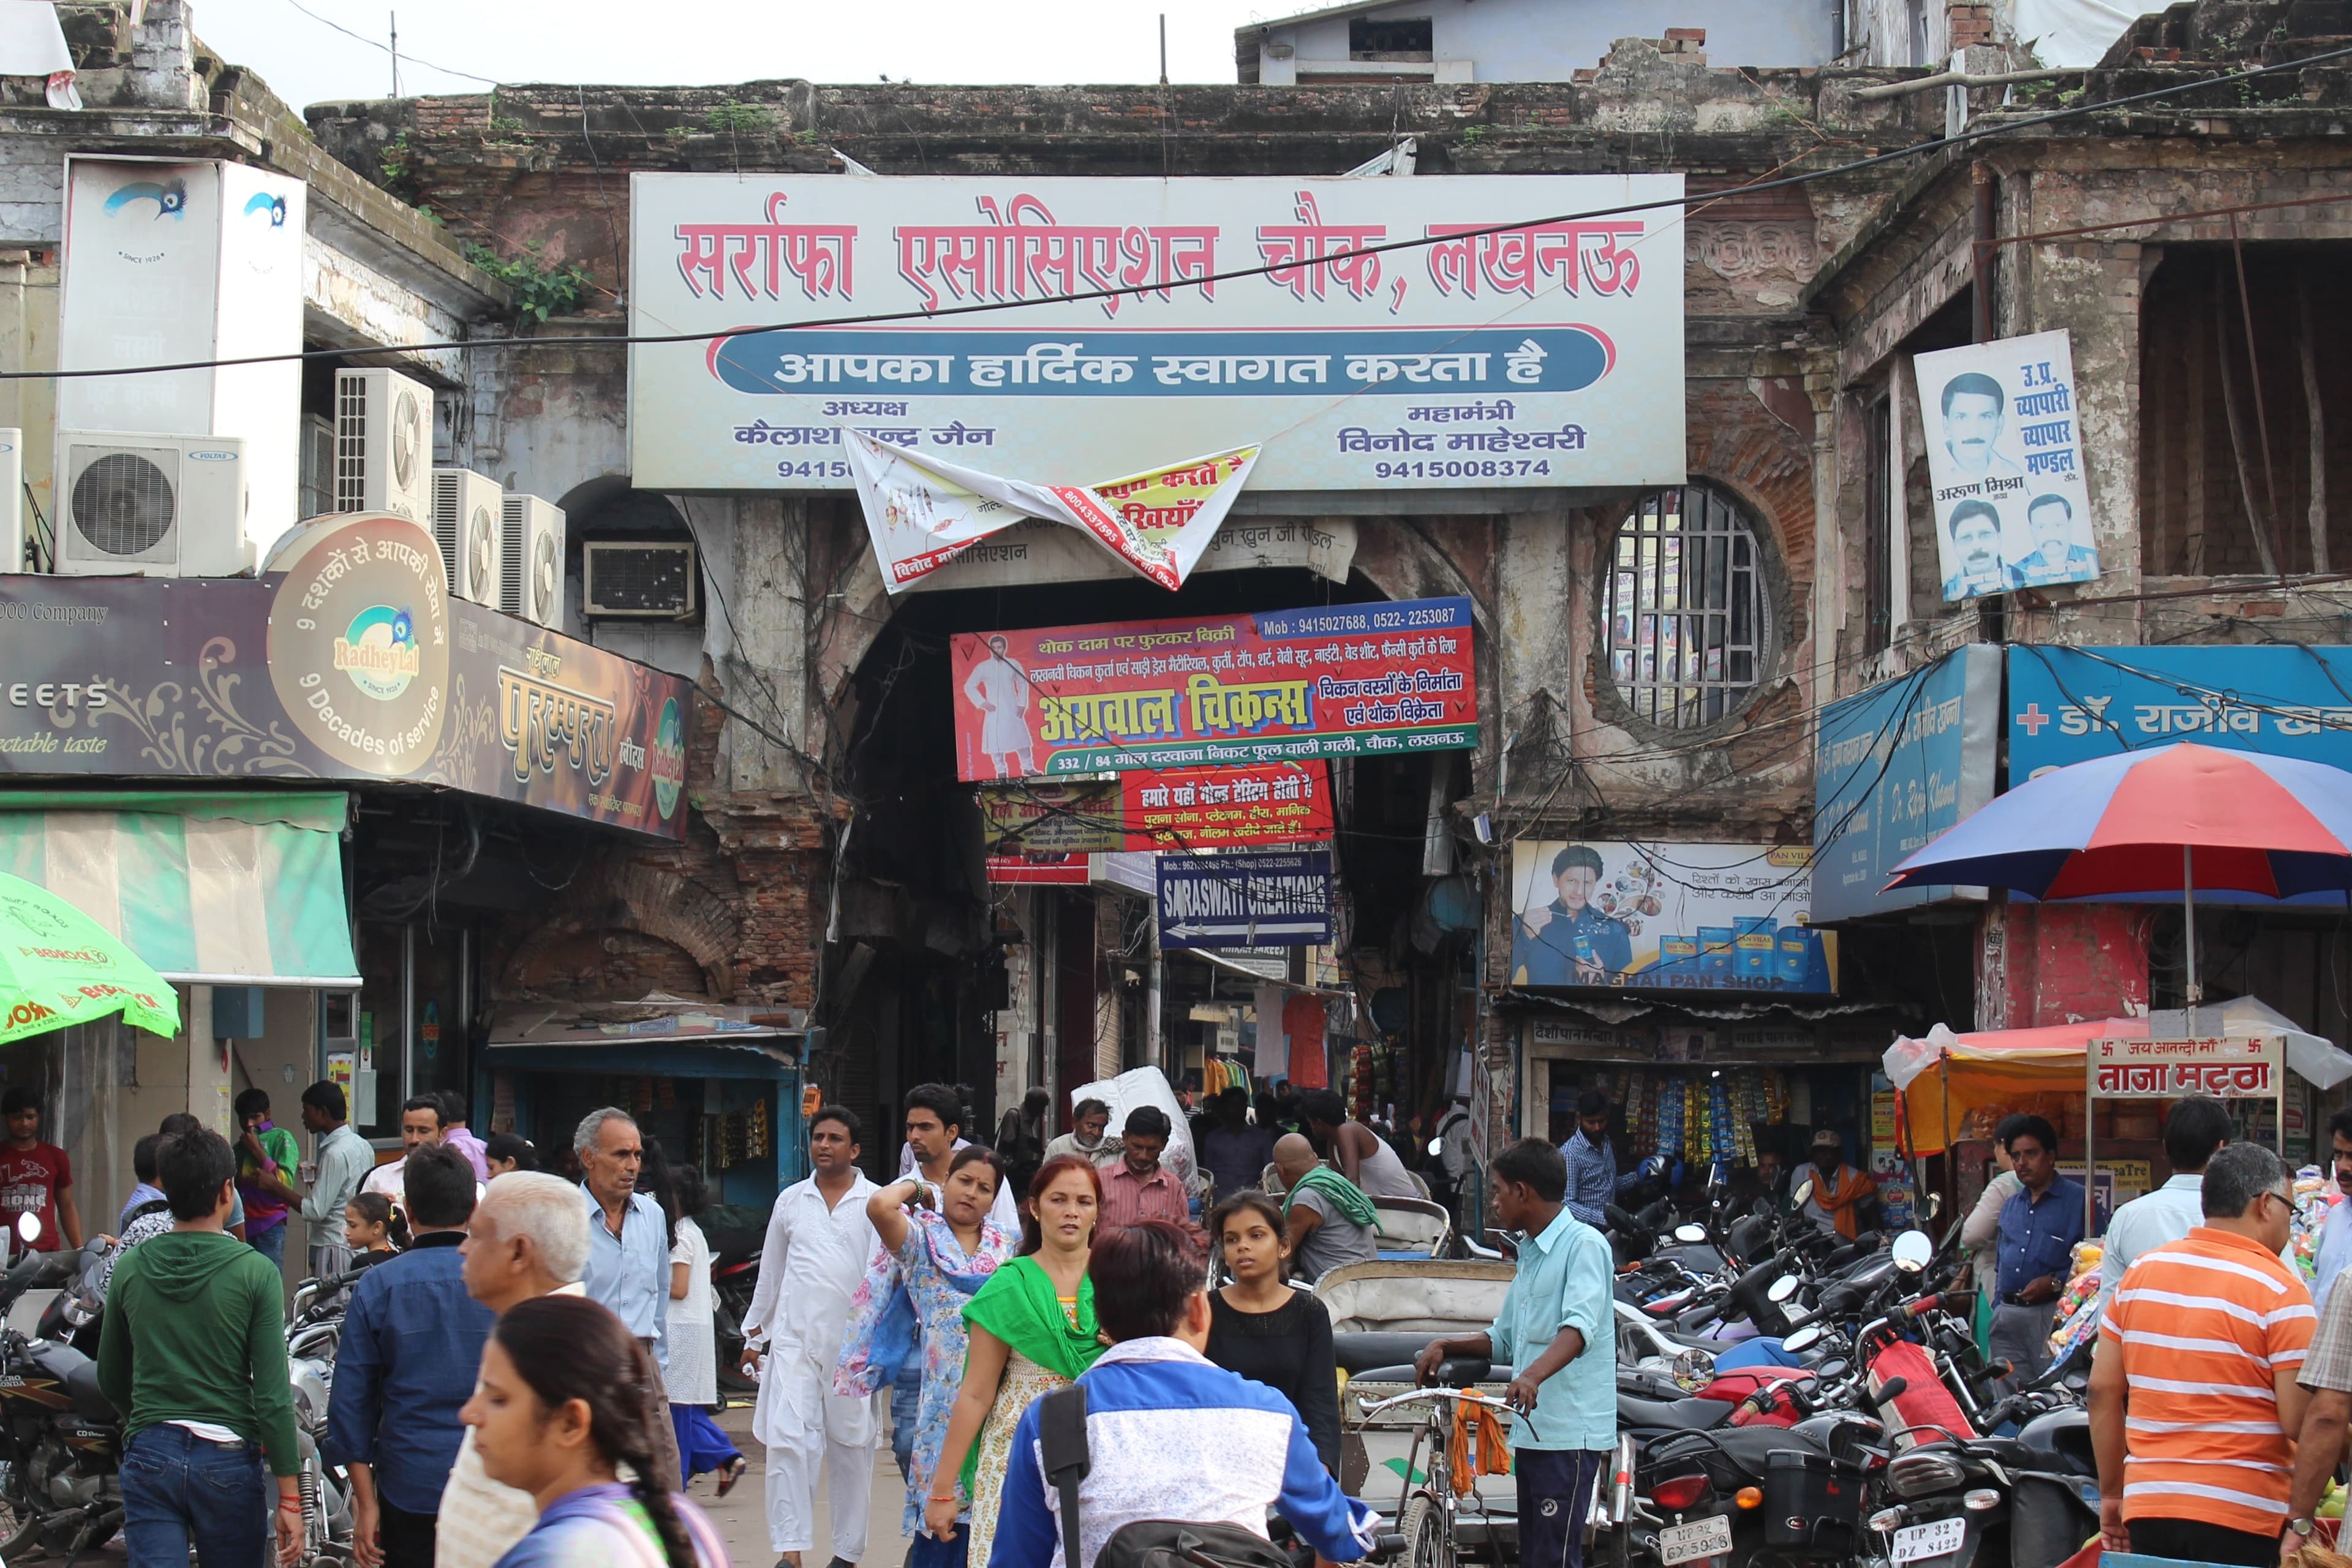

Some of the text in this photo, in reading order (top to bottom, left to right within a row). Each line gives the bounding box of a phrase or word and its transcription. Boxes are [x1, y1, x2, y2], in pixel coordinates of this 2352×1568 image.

[123, 252, 160, 264] SINCE 1926
[675, 191, 1645, 318] सर्राफा एसोसिएशन चौक, लखनऊ
[774, 338, 1547, 386] आपका हार्दिक स्वागत करता है
[2020, 361, 2057, 387] उ.प्र.
[822, 401, 909, 417] अध्यक्ष
[1408, 399, 1516, 423] महामंत्री
[2014, 383, 2070, 417] व्यापारी
[734, 418, 842, 445] कैलाश
[930, 421, 996, 447] जैन
[1338, 424, 1587, 452] विनोद माहेश्वरी
[2020, 420, 2071, 447] व्यापार
[1376, 460, 1550, 478] 9415008374
[2025, 448, 2075, 476] मण्डल
[1985, 476, 2024, 494] मिश्रा
[1064, 490, 1118, 543] 8004337595
[301, 549, 352, 609] दशकों
[350, 536, 371, 565] से
[375, 540, 429, 581] आपकी
[425, 575, 440, 620] सेवा
[32, 602, 108, 626] Company
[1264, 620, 1288, 636] Mob
[1298, 614, 1370, 633] 9415027688,
[1373, 612, 1405, 628] 0522-
[1408, 608, 1455, 625] 2253087
[1038, 625, 1235, 655] थोक दाम पर फुटकर बिक्री
[335, 639, 419, 674] RadheyLal
[526, 641, 562, 679] राधेलाल
[1030, 662, 1065, 684] लखनवी
[1066, 663, 1093, 680] चिकन
[1095, 660, 1114, 683] कुर्ता
[1117, 658, 1129, 676] एवं
[1439, 636, 1457, 655] लिए
[0, 683, 108, 708] EETS
[368, 682, 398, 694] SINCE 1926
[1318, 675, 1359, 699] चिकन
[1397, 673, 1414, 693] के
[1415, 667, 1463, 693] निर्माता
[299, 673, 439, 756] 9 Decades of service
[1039, 673, 1312, 742] अग्रवाल चिकन्स
[1344, 698, 1444, 726] एवं थोक विक्रेता
[2058, 693, 2262, 734] डॉ. राजीव
[498, 665, 615, 786] परम्परा
[64, 736, 108, 753] taste
[1058, 755, 1080, 770] 332
[1095, 753, 1111, 767] 84
[1152, 748, 1203, 763] दरवाजा
[1207, 744, 1250, 760] निकट
[1252, 743, 1283, 761] फूल
[1286, 737, 1319, 756] वाली
[1323, 736, 1360, 754] गली,
[1365, 734, 1403, 751] चौक,
[1408, 731, 1464, 747] लखनऊ
[1140, 784, 1169, 809] हमारे
[1173, 782, 1195, 807] यहाँ
[1273, 775, 1300, 800] होती
[1144, 813, 1172, 829] पुराना
[1175, 809, 1201, 823] सोना,
[1200, 825, 1229, 839] नीलम
[1692, 872, 1719, 884] रिश्तों
[1725, 873, 1740, 886] को
[1745, 876, 1771, 886] खास
[1164, 877, 1245, 918] SARASWATI
[1247, 875, 1326, 916] CREATIONS
[1760, 891, 1775, 901] आ
[1781, 889, 1811, 903] जाओ
[1670, 974, 1714, 988] PAN
[1722, 974, 1784, 990] SHOP
[1559, 1028, 1581, 1041] पान
[2098, 1063, 2171, 1094] ताजा
[1910, 1523, 1950, 1542] UP 32
[1898, 1536, 1958, 1558] DZ 8422
